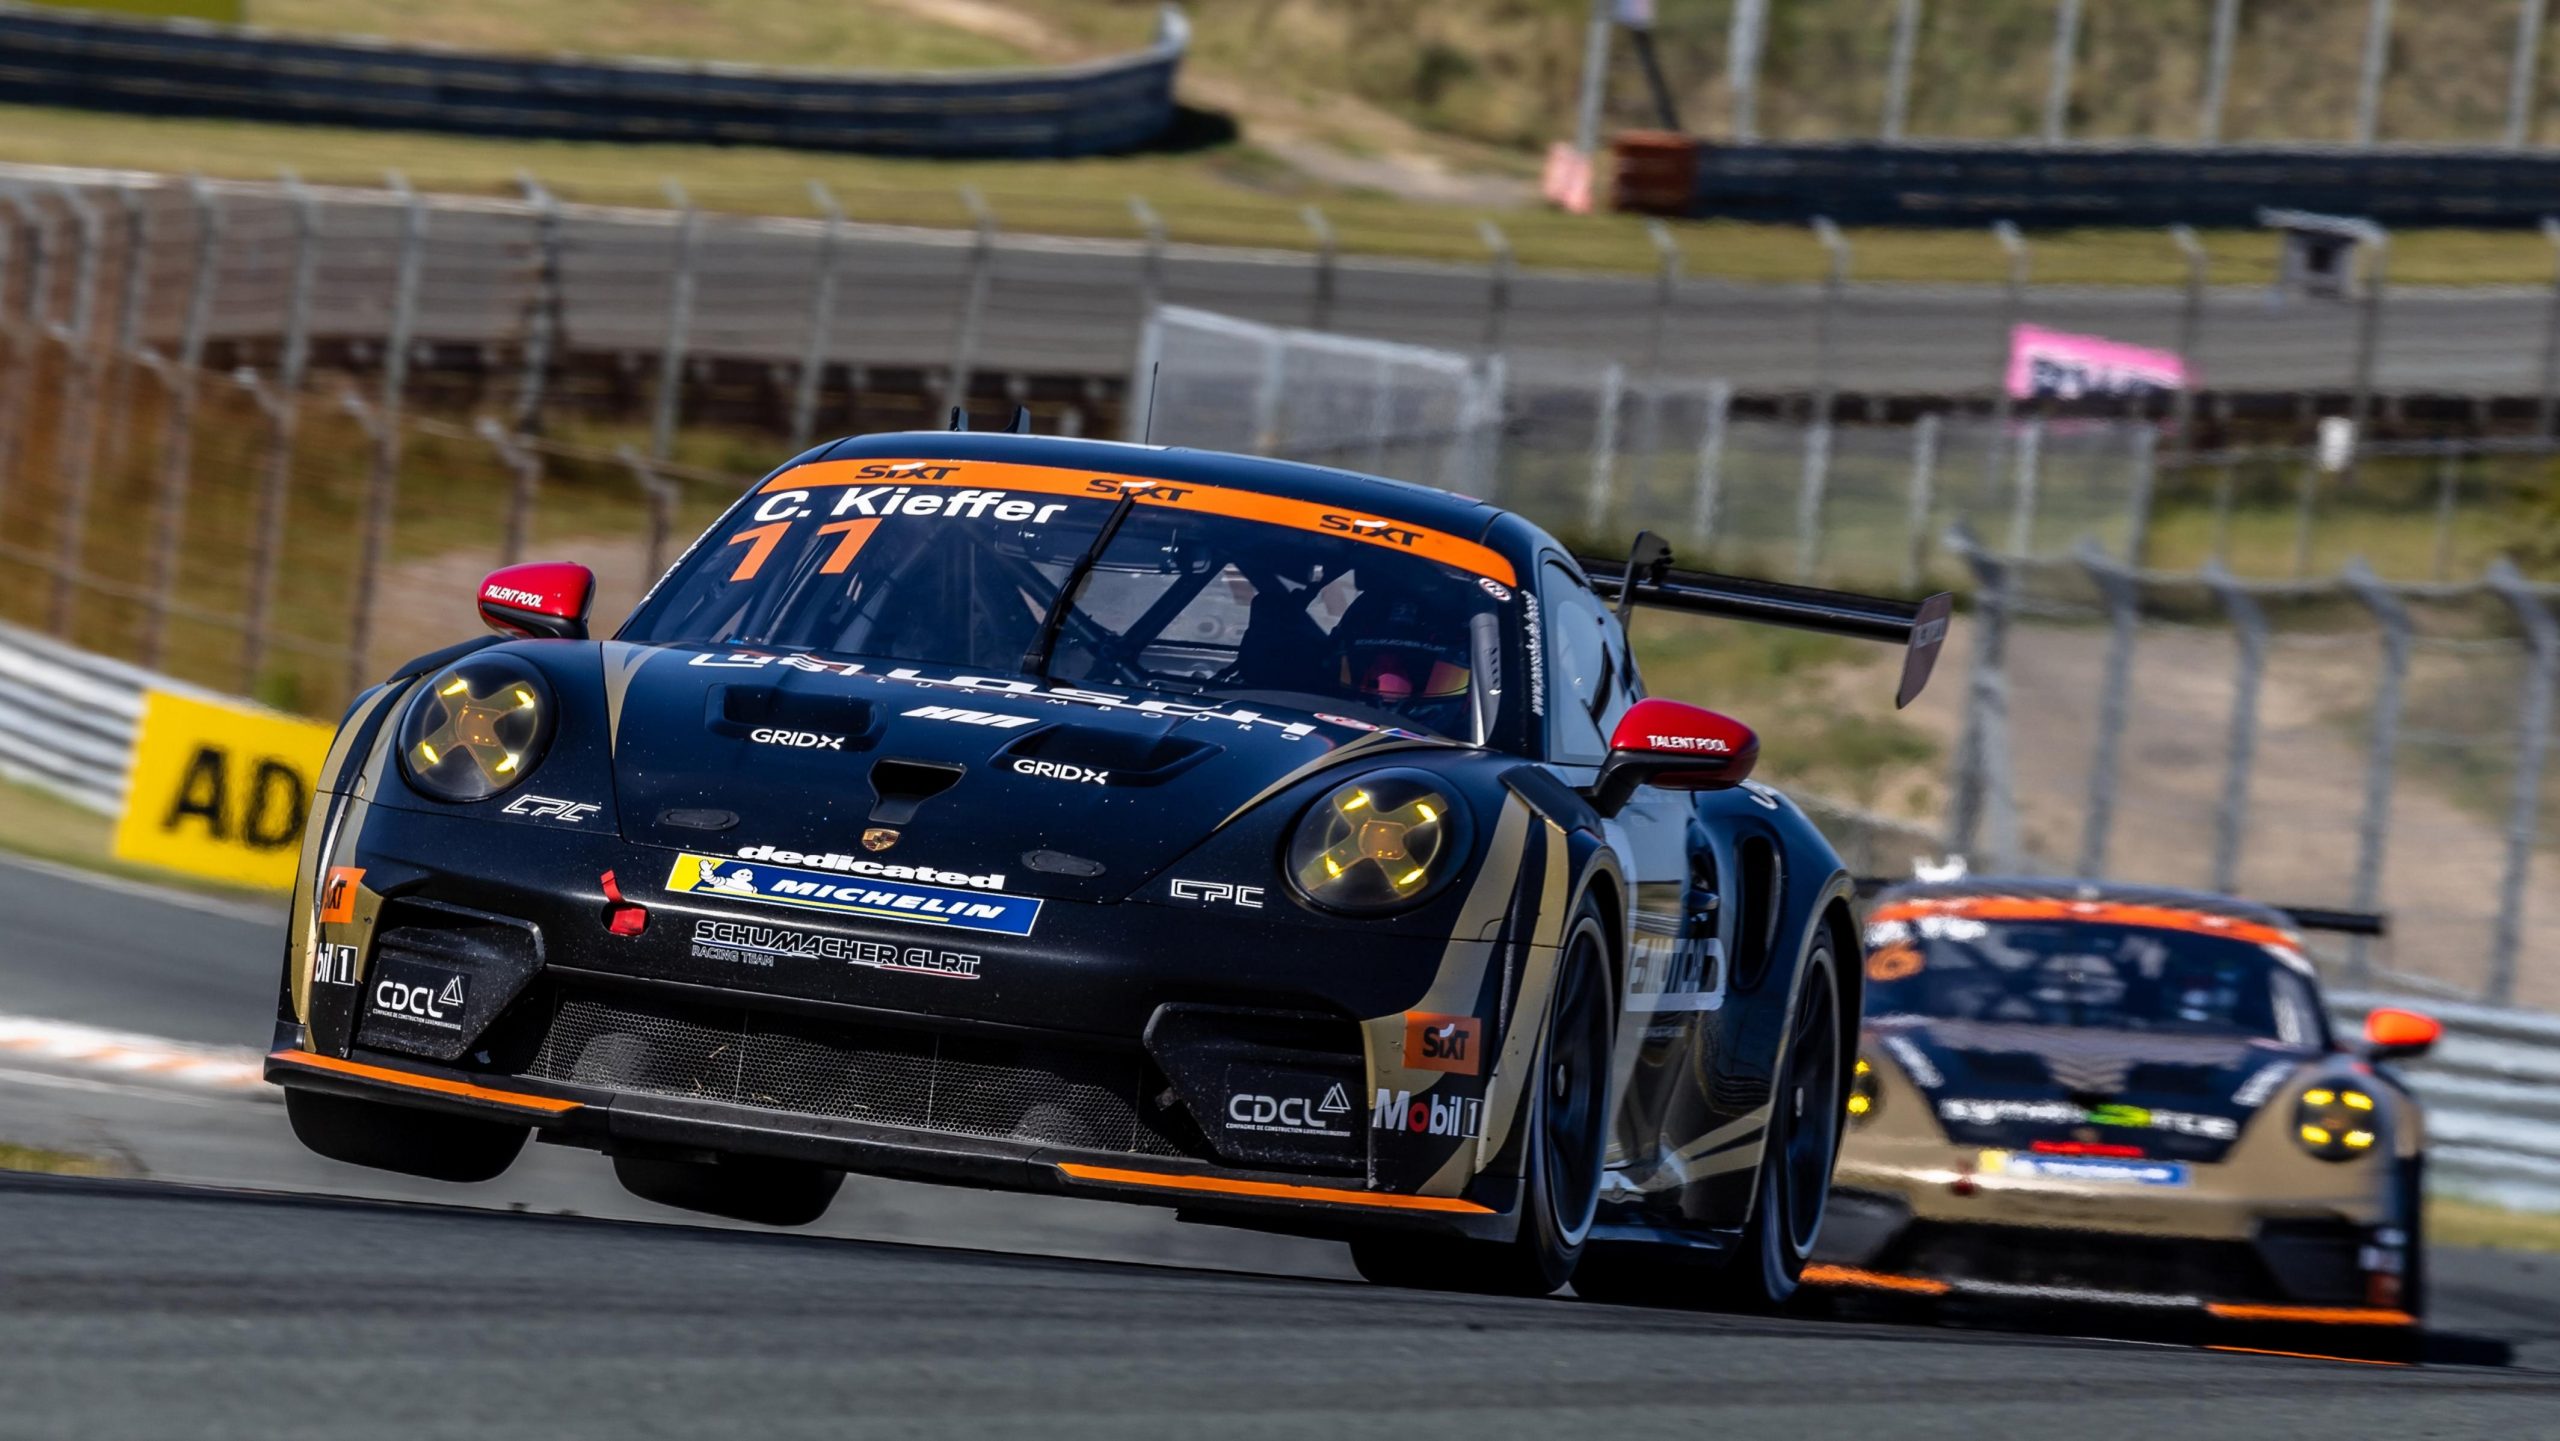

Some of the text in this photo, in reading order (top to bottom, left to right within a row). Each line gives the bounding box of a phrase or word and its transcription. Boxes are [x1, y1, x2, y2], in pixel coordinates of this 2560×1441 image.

[754, 486, 1067, 524] C. Kieffer
[728, 517, 883, 583] 11
[485, 585, 544, 608] TALENT POOL
[876, 677, 1301, 741] LUXEMBOURG
[1646, 735, 1731, 752] TALENT POOL
[737, 845, 1005, 890] dedicated
[770, 879, 1005, 920] MICHELIN
[691, 944, 774, 968] RACING TEAM
[695, 920, 980, 976] SCHUMACHER CLRT
[377, 980, 443, 1019] CDCL
[1229, 1093, 1327, 1128] CDCL
[1373, 1088, 1462, 1137] Mobil
